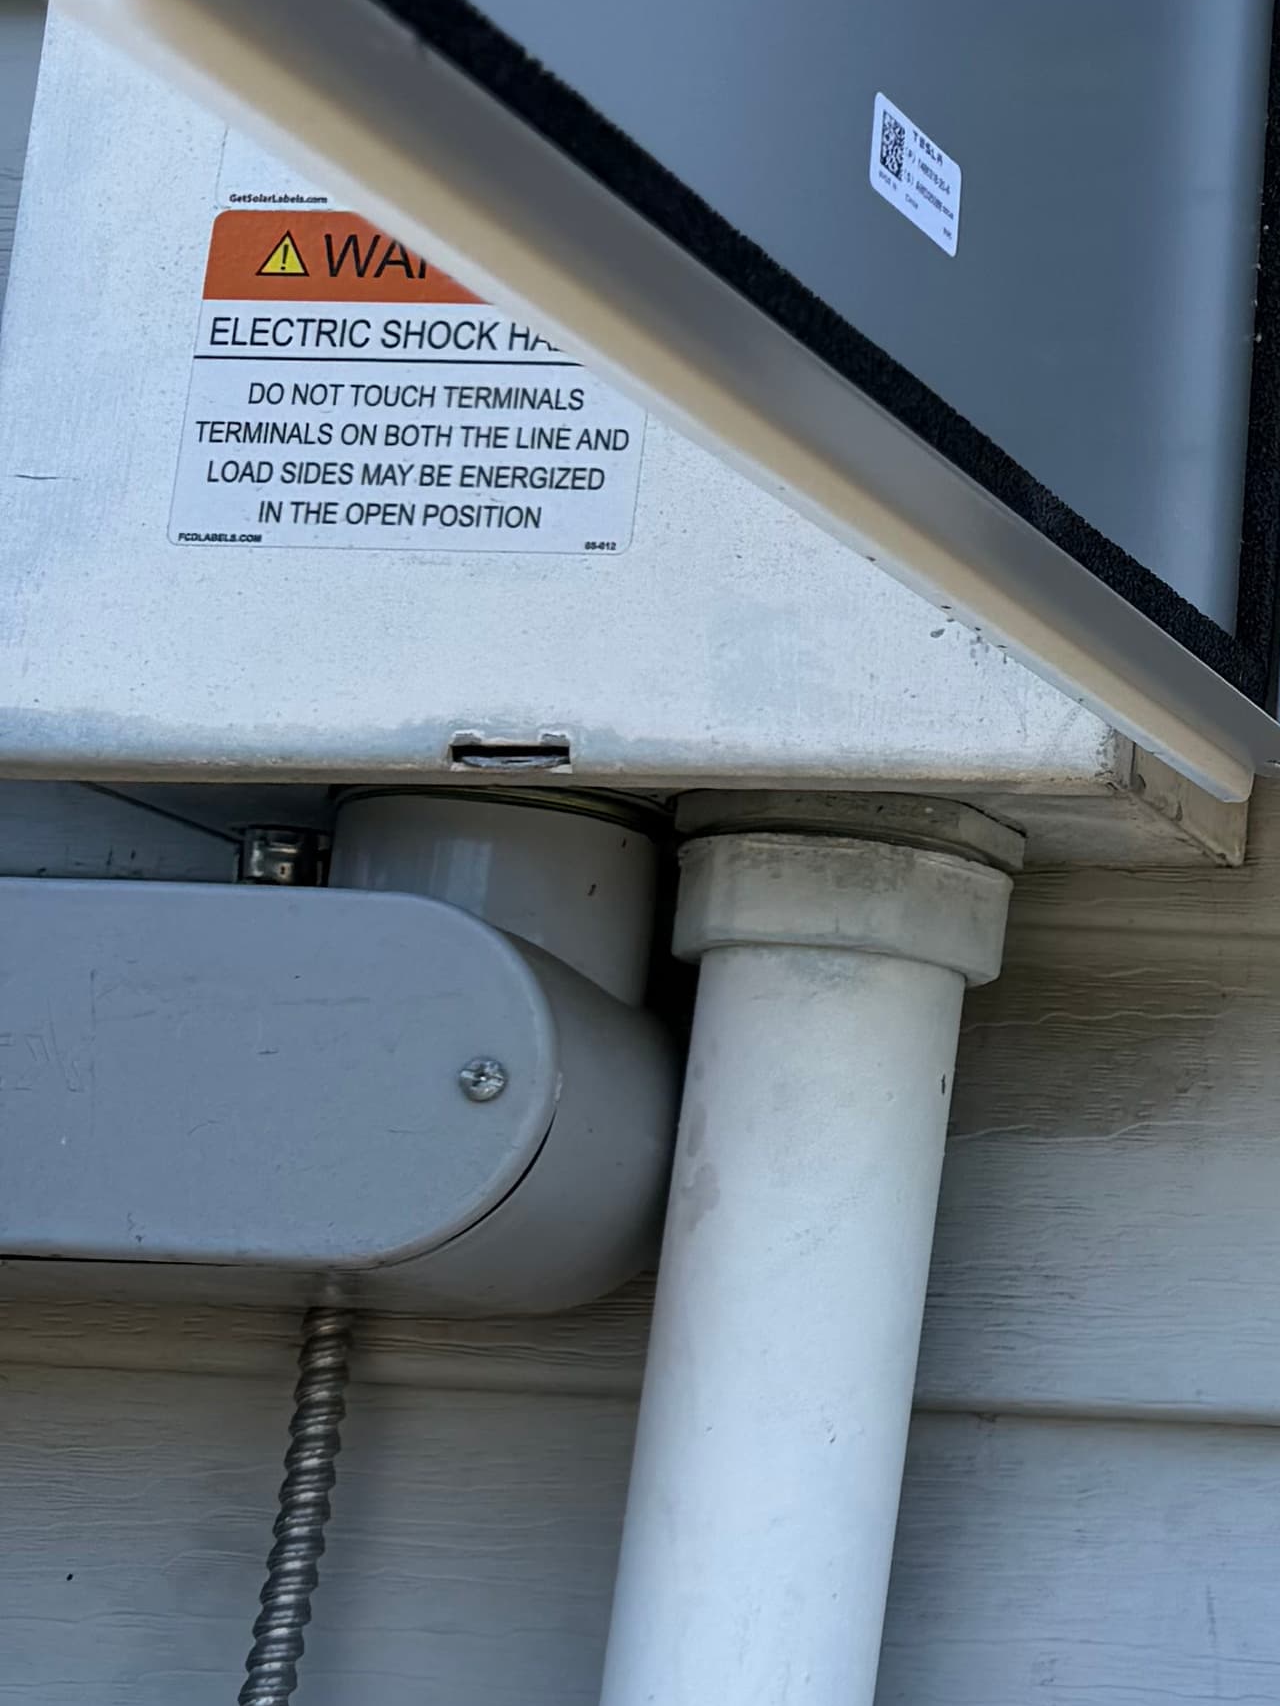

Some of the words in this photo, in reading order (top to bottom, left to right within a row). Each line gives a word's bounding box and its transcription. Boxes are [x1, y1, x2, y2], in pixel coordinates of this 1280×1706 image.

[210, 317, 371, 348] ELECTRIC
[381, 319, 500, 350] SHOCK
[248, 382, 285, 405] DO
[291, 383, 345, 406] NOT
[350, 384, 436, 408] TOUCH
[443, 386, 584, 411] TERMINALS
[195, 421, 333, 445] TERMINALS
[341, 423, 378, 446] ON
[384, 424, 453, 447] BOTH
[460, 425, 510, 449] THE
[516, 427, 572, 450] LINE
[575, 428, 629, 451] AND
[207, 460, 274, 484] LOAD
[280, 461, 354, 485] SIDES
[361, 463, 414, 486] MAY
[419, 464, 453, 487] BE
[459, 465, 605, 490] ENERGIZED
[258, 501, 283, 523] IN
[290, 501, 339, 524] THE
[345, 502, 416, 526] OPEN
[422, 504, 542, 529] POSITION
